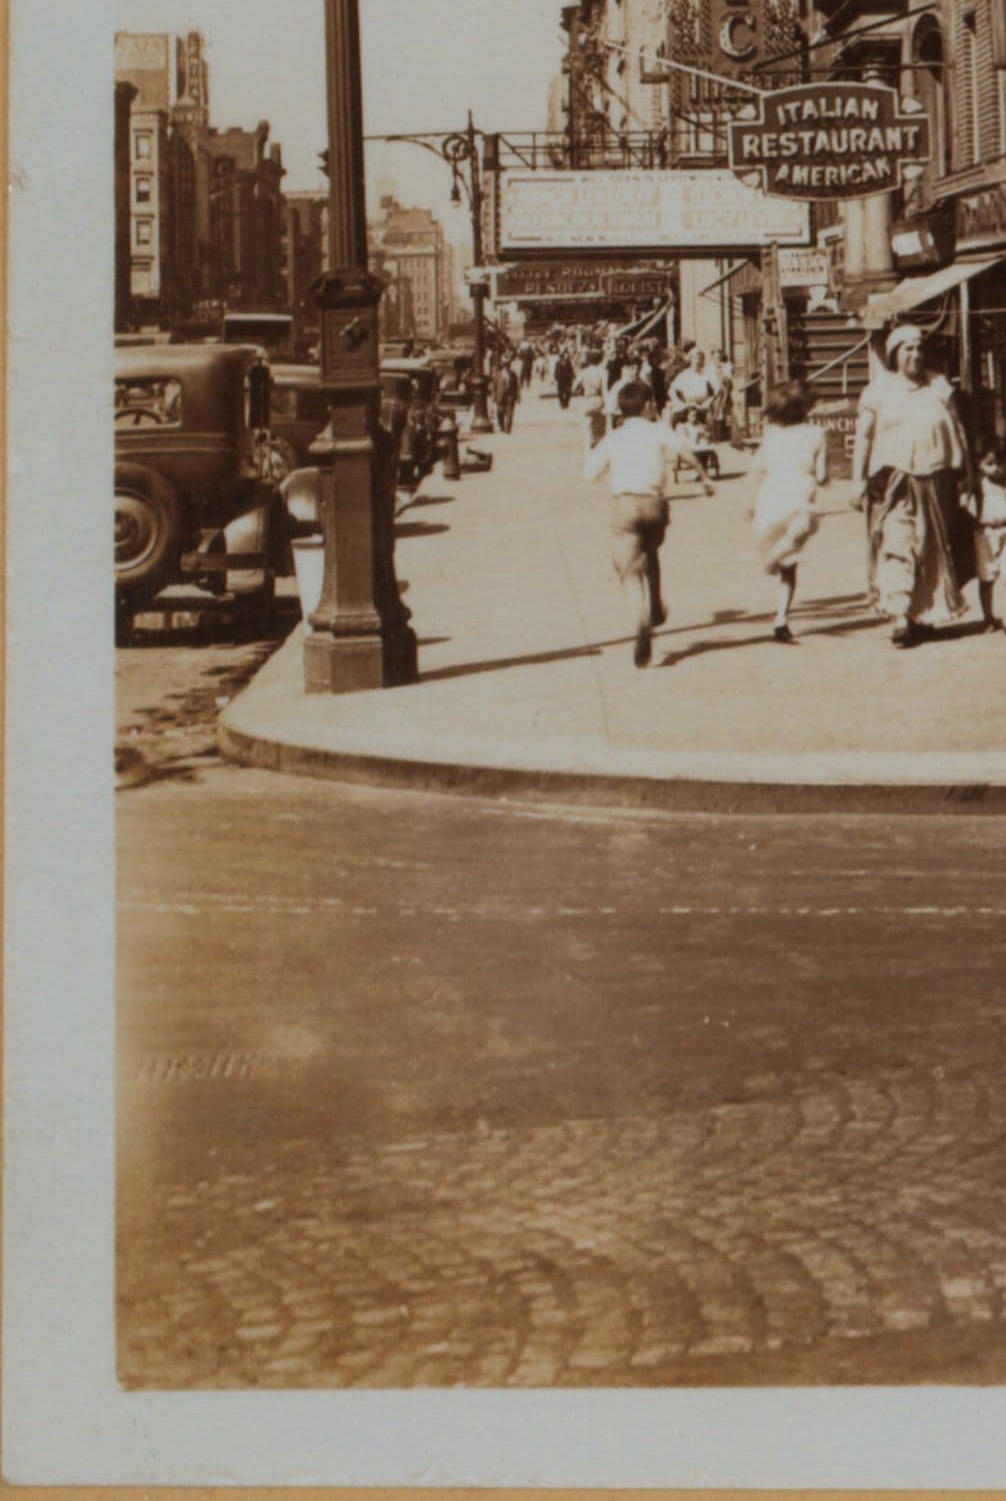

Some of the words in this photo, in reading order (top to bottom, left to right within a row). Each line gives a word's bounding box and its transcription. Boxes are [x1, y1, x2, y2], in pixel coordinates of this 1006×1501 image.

[776, 97, 880, 126] ITALIAN
[742, 125, 920, 158] RESTAURANT
[774, 156, 892, 187] AMERICAN
